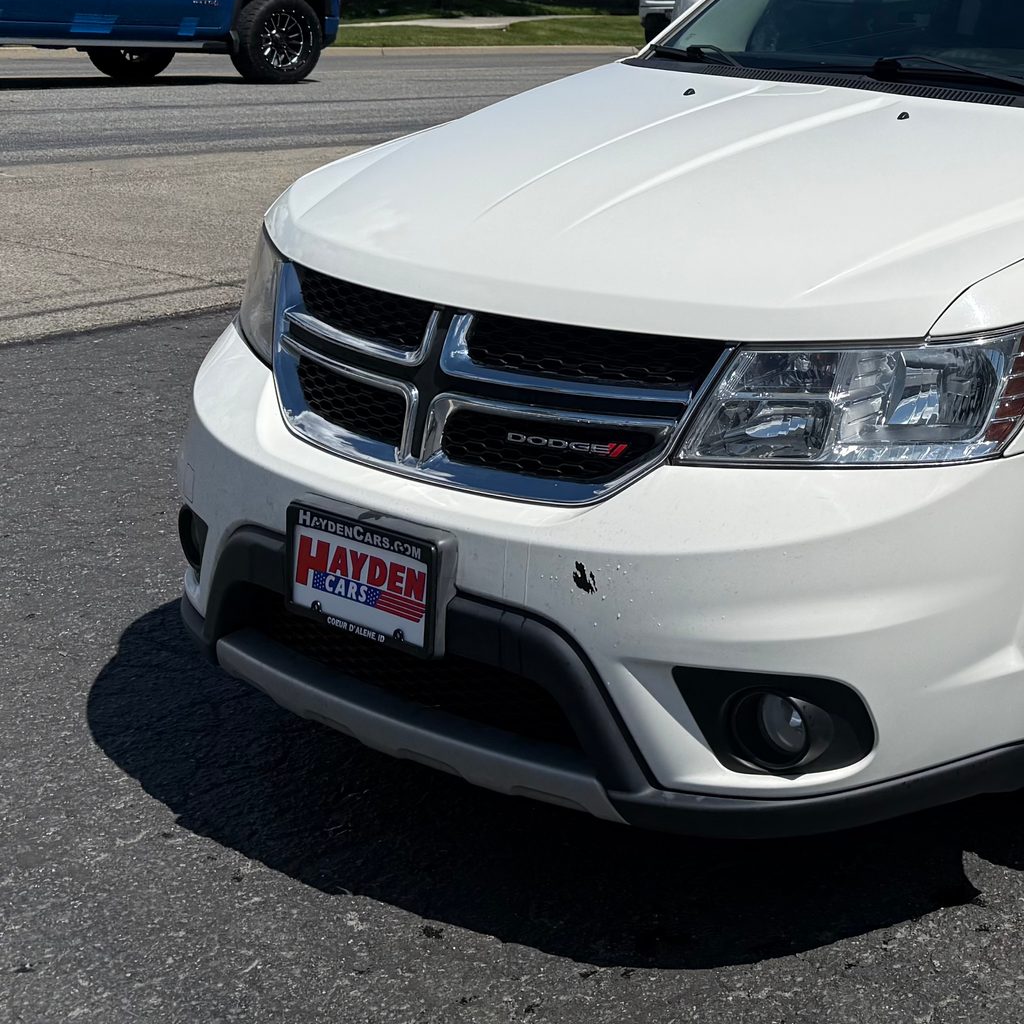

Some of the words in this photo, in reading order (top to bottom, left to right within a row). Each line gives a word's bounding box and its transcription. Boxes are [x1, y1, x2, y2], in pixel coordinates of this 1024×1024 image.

[507, 432, 611, 454] DODGE
[295, 534, 427, 603] HAYDEN
[324, 573, 369, 604] CARS
[326, 616, 348, 630] COEUR
[377, 634, 386, 643] ID
